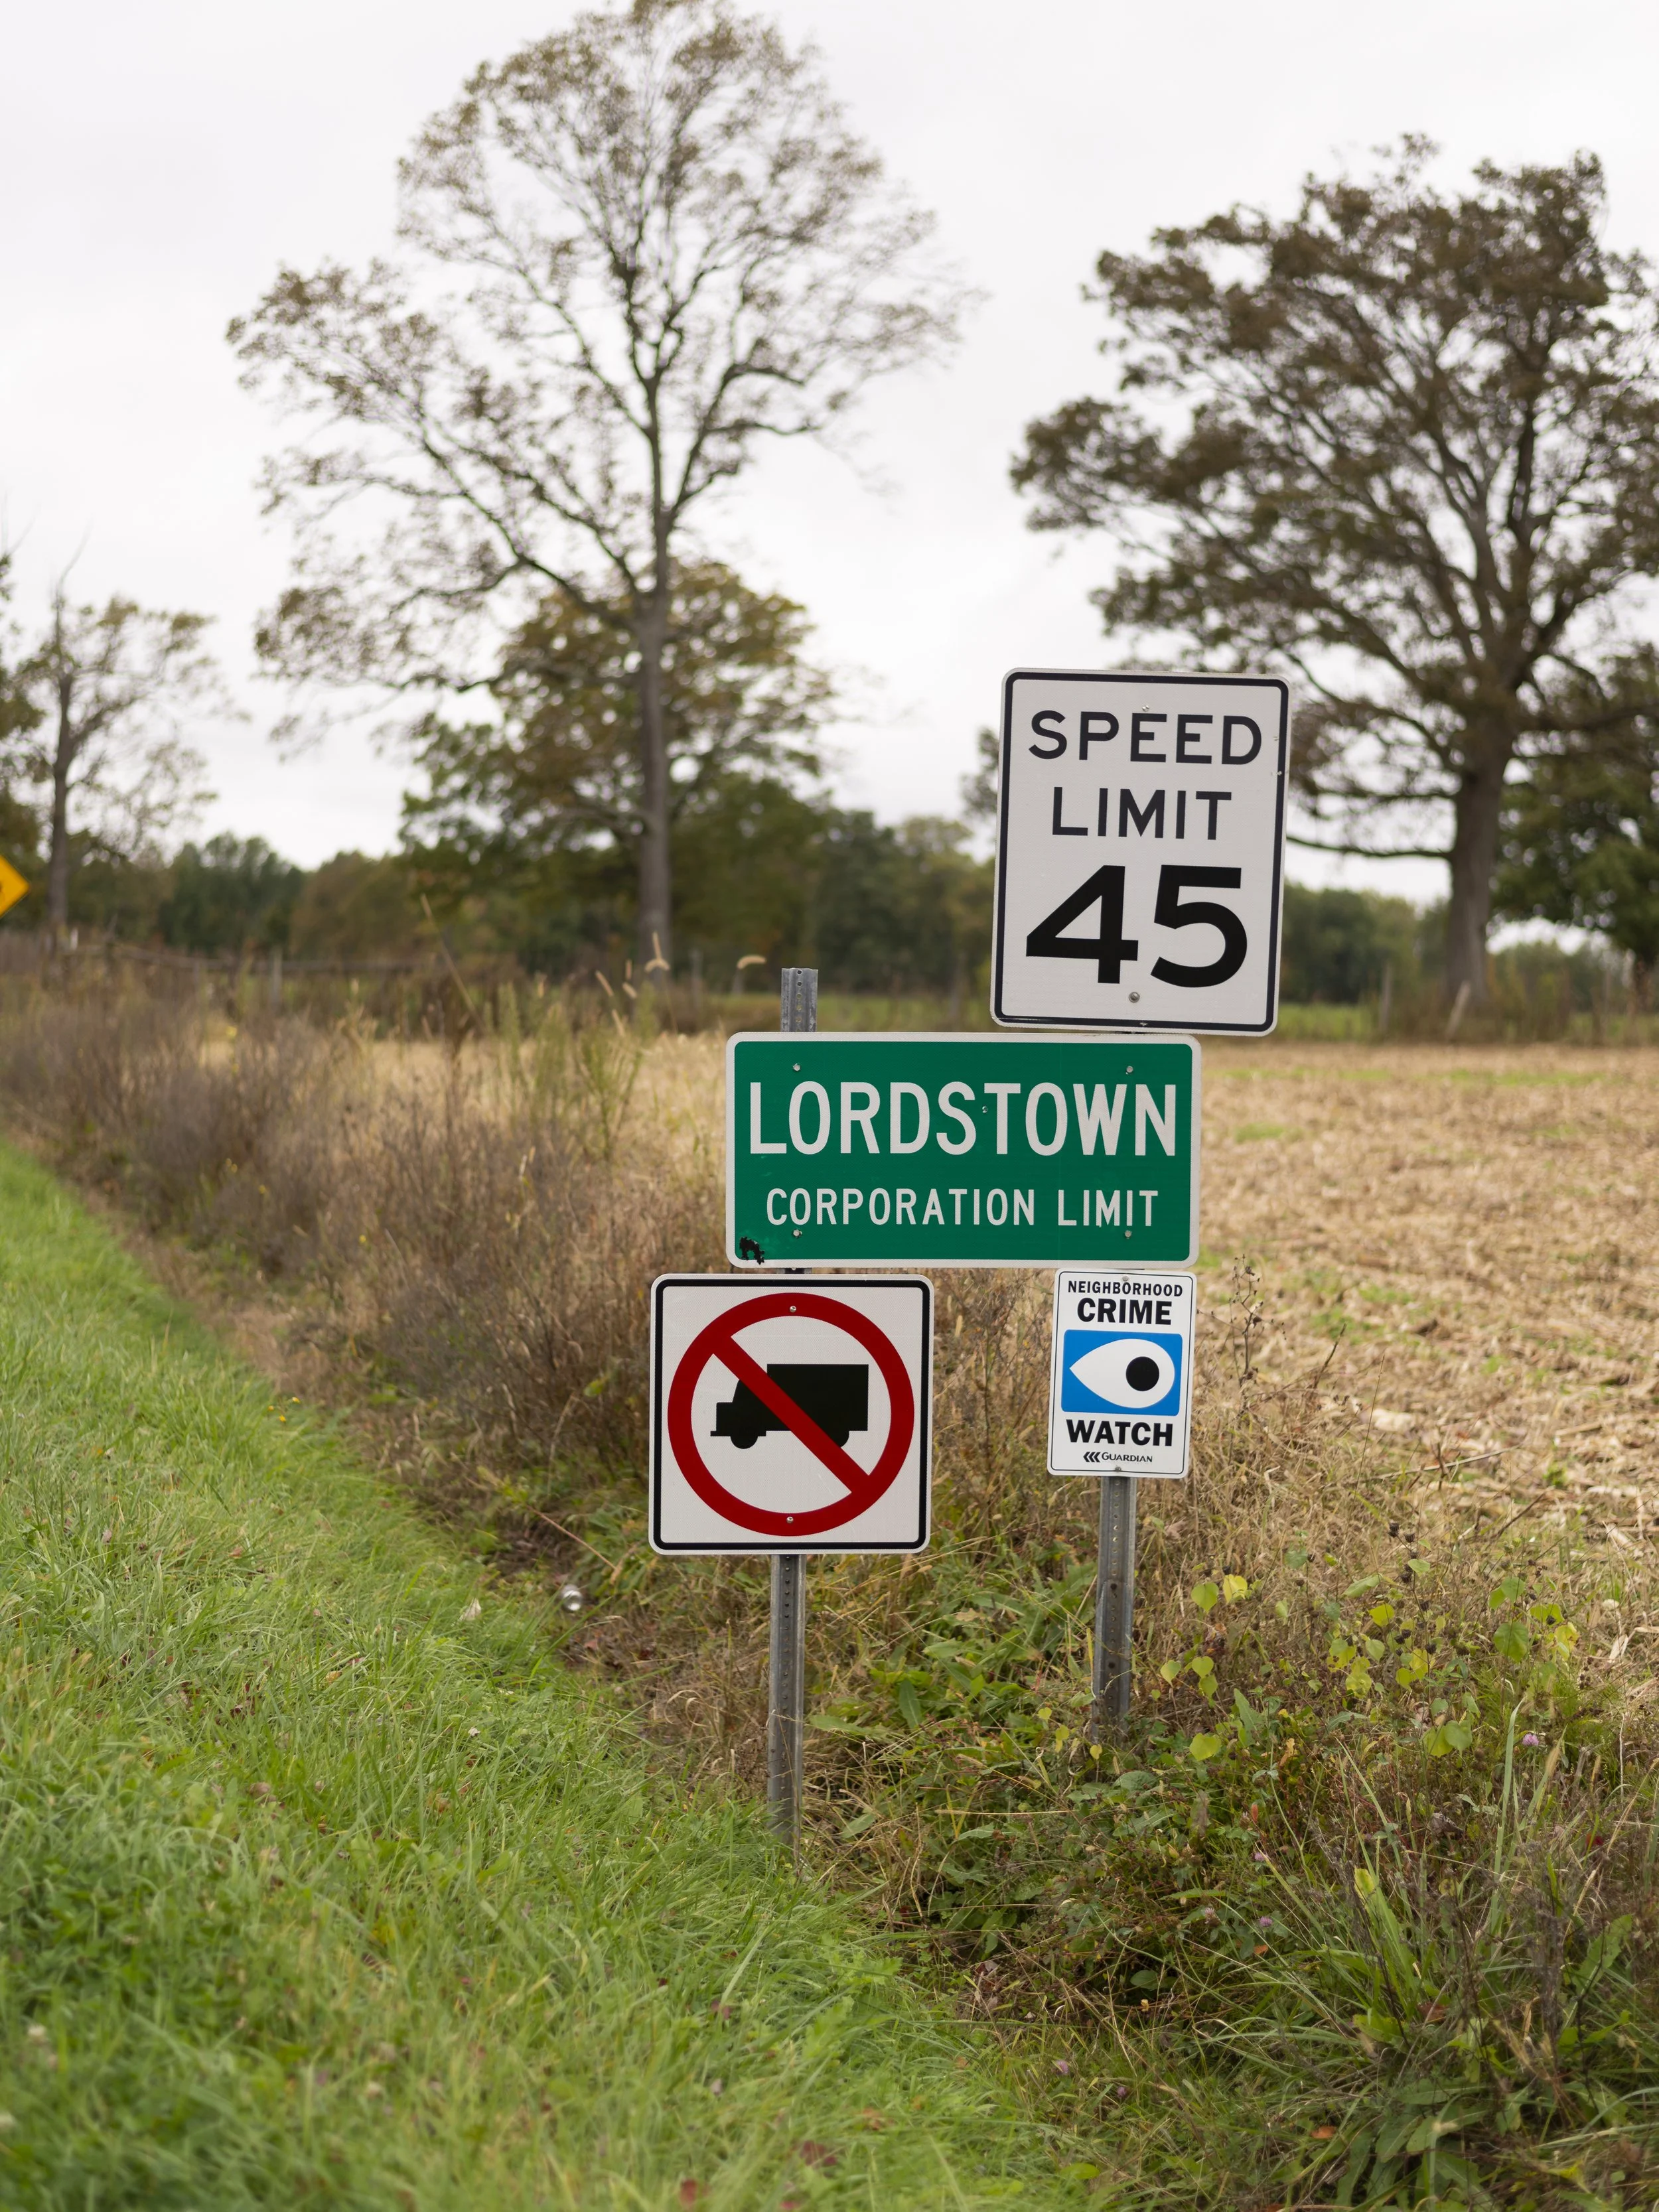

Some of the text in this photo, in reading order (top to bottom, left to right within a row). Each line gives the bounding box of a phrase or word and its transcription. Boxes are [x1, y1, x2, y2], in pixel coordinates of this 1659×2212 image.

[1029, 710, 1262, 765] SPEED
[1052, 786, 1232, 840] LIMIT
[1026, 864, 1248, 988] 45
[750, 1081, 1176, 1156] LORDSTOWN
[766, 1188, 1158, 1226] CORPORATION LIMIT
[1068, 1280, 1183, 1297] NEIGHBORHOOD
[1077, 1298, 1173, 1325] CRIME
[1066, 1419, 1173, 1446] WATCH
[1102, 1452, 1153, 1463] GUARDIAN
